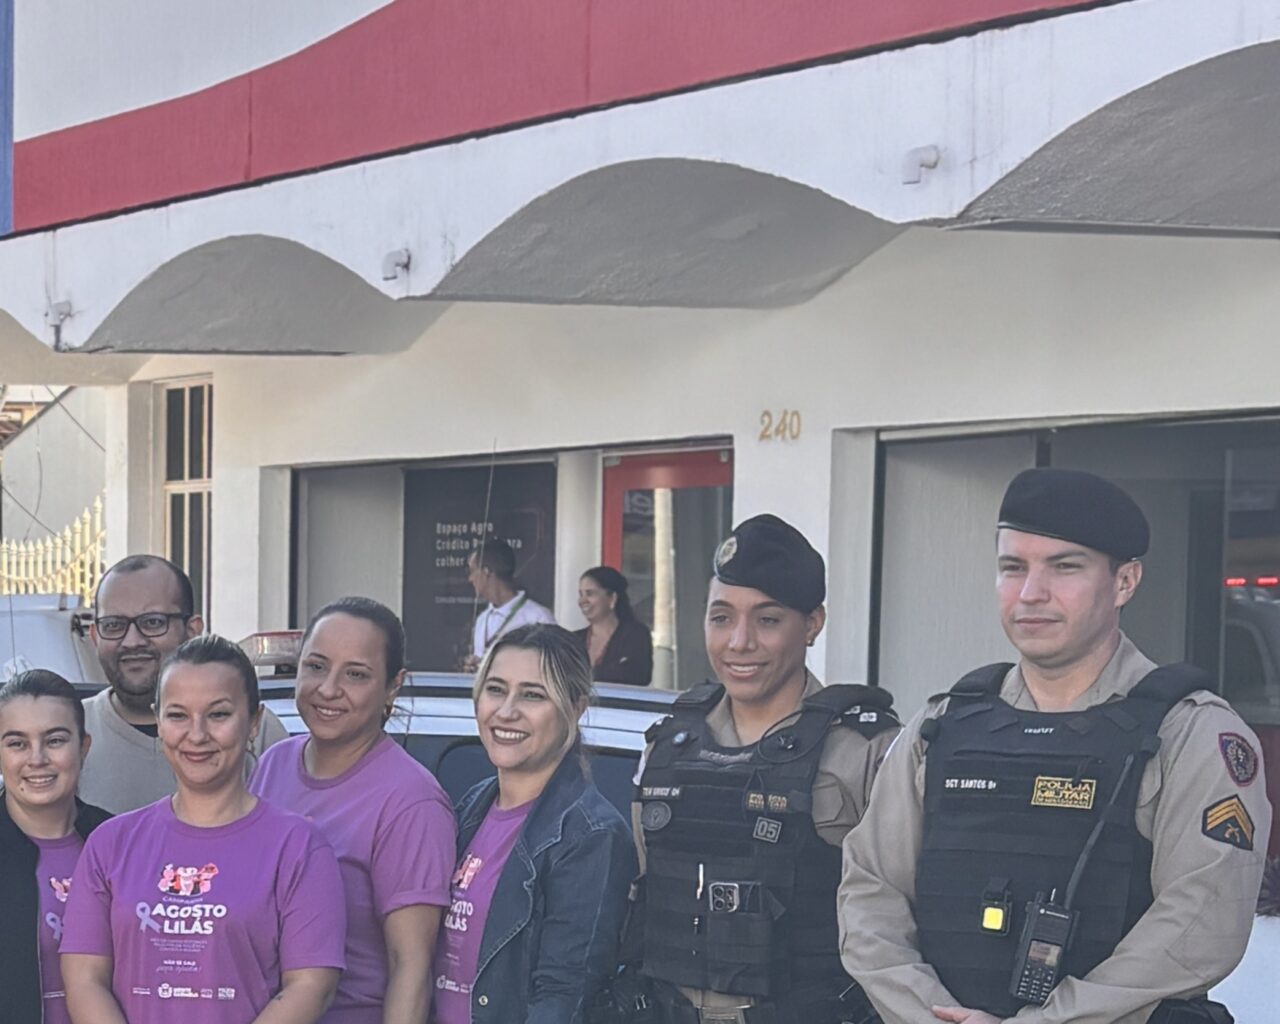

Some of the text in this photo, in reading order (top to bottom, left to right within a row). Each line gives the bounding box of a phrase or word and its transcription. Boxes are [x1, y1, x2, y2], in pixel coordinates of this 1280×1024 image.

[759, 409, 801, 441] 240
[757, 820, 778, 838] 05
[151, 903, 227, 919] AGOSTO
[163, 917, 214, 935] LILÁS
